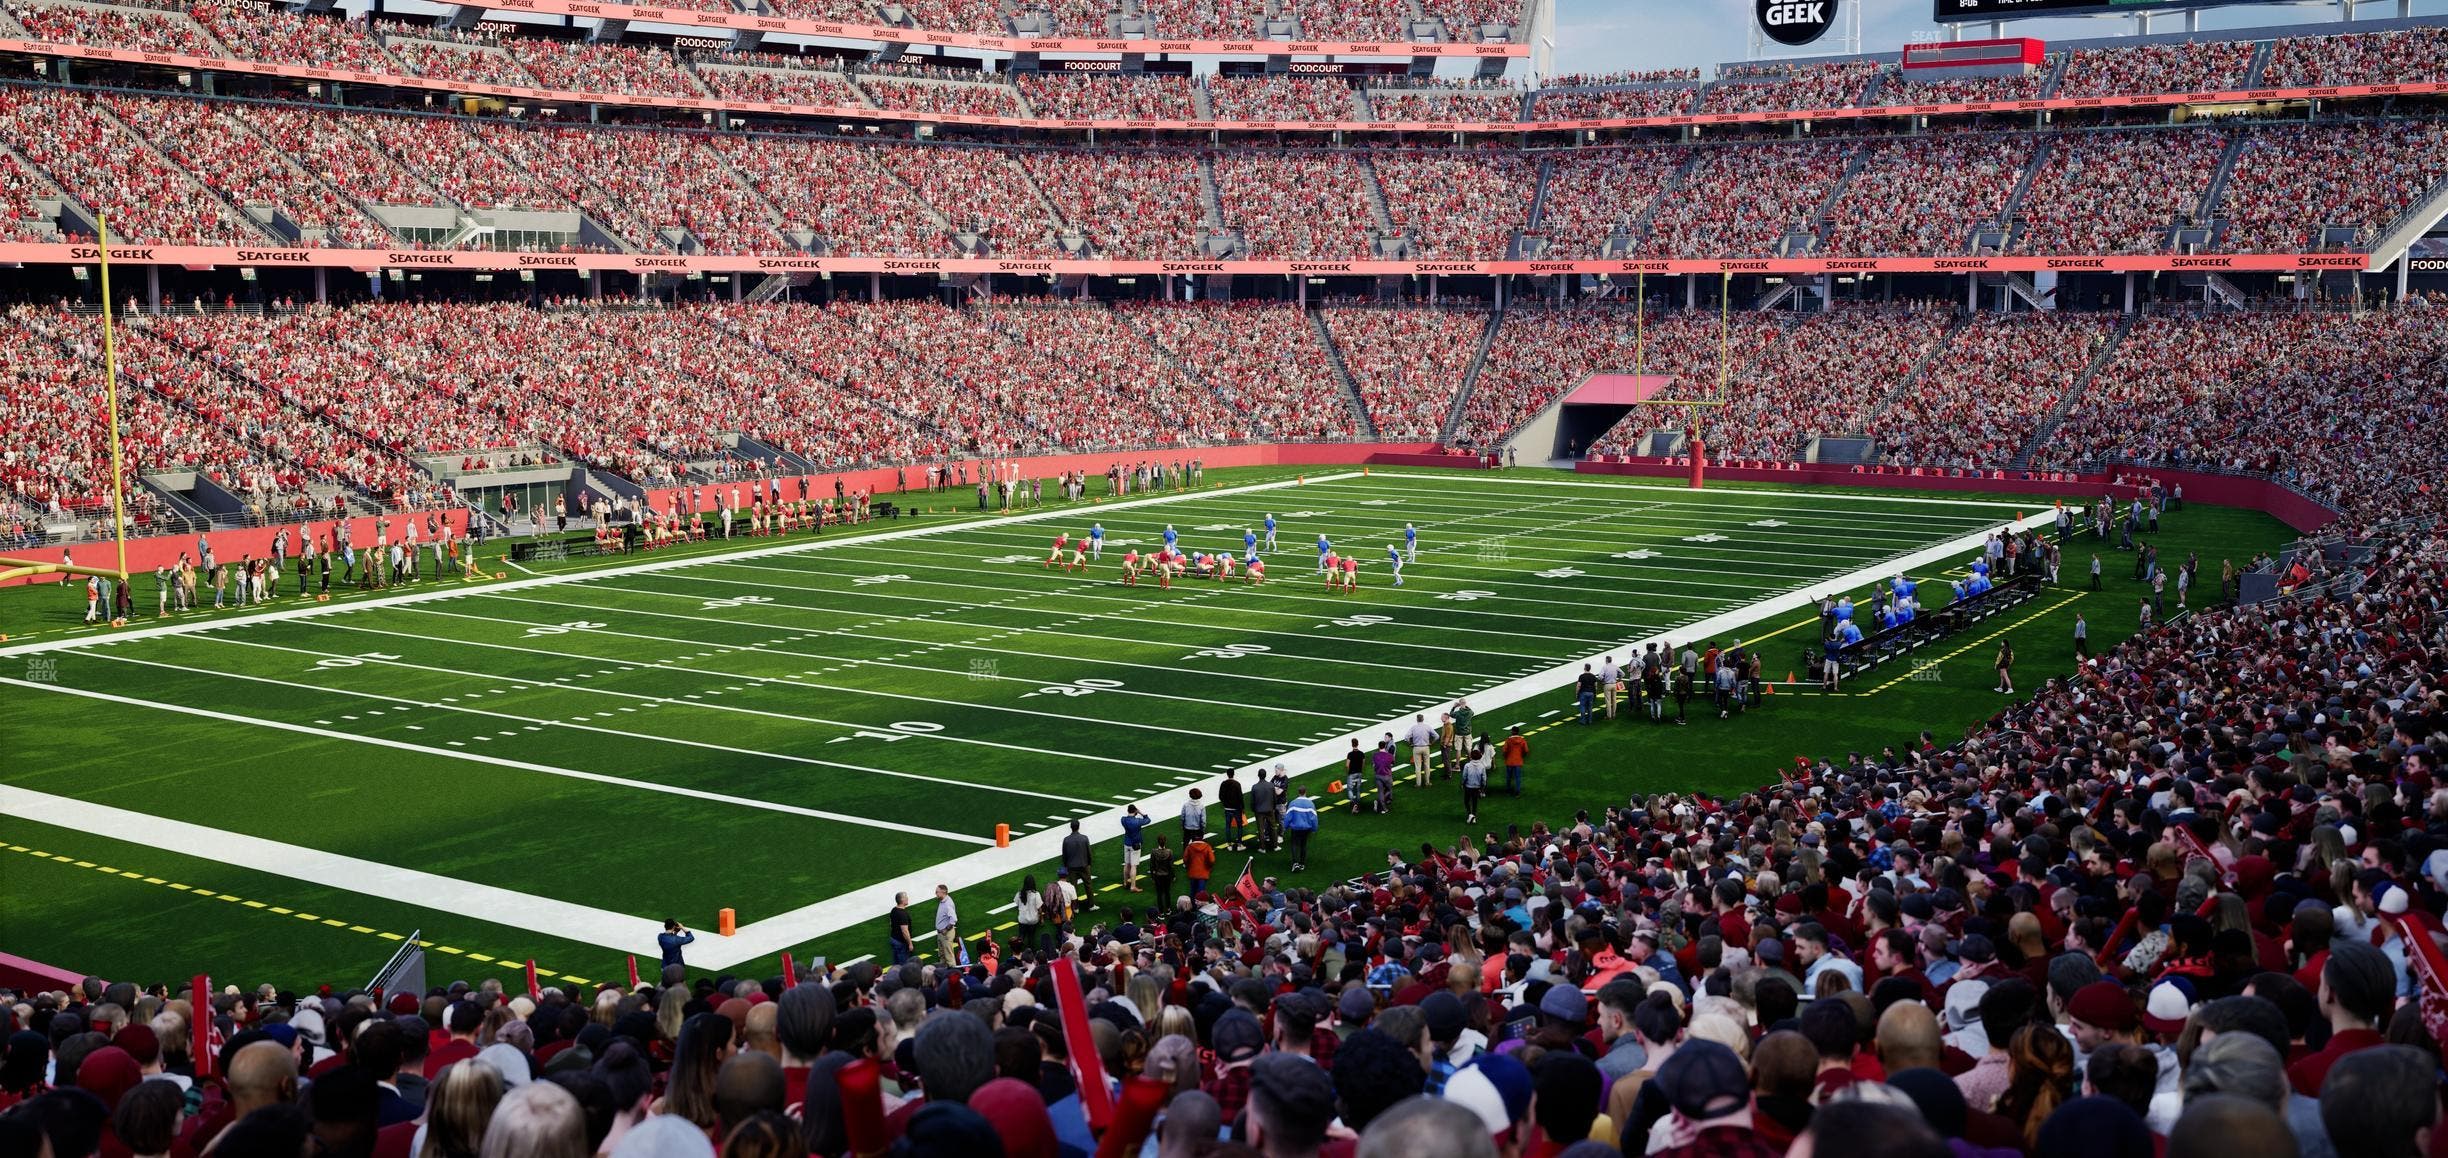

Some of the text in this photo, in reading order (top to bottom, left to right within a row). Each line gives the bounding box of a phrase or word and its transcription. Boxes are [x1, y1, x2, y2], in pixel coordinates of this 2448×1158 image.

[501, 0, 534, 8] SEATGEEK
[568, 4, 600, 13] SEATGEEK
[632, 9, 663, 18] SEATGEEK
[1766, 2, 1824, 26] GEEK
[697, 15, 727, 24] SEATGEEK
[757, 20, 786, 28] SEATGEEK
[815, 25, 842, 33] SEATGEEK
[873, 30, 899, 38] SEATGEEK
[927, 34, 952, 42] SEATGEEK
[675, 37, 732, 48] FOODCOURT
[24, 43, 54, 53] SEATGEEK
[84, 49, 112, 58] SEATGEEK
[144, 54, 172, 63] SEATGEEK
[199, 59, 226, 68] SEATGEEK
[1064, 62, 1121, 70] FOODCOURT
[253, 64, 278, 73] SEATGEEK
[305, 68, 330, 77] SEATGEEK
[2308, 88, 2338, 96] SEATGEEK
[2369, 85, 2400, 93] SEATGEEK
[1965, 103, 1991, 111] SEATGEEK
[71, 248, 154, 260] SEAGEEK
[237, 251, 310, 262] SEATGEEK
[388, 254, 453, 263] SEATGEEK
[519, 256, 576, 265] SEATGEEK
[634, 258, 687, 267] SEATGEEK
[759, 260, 820, 269] SEATGEEK
[883, 261, 940, 269] SEATGEEK
[1933, 260, 1988, 269] SEATGEEK
[2047, 259, 2105, 268] SEATGEEK
[2171, 258, 2232, 267] SEATGEEK
[2298, 257, 2362, 266] SEATGEEK
[999, 263, 1052, 271] SEATGEEK
[1162, 264, 1224, 272] SEATGEEK
[1289, 264, 1351, 272] SEATGEEK
[1415, 264, 1477, 272] SEATGEEK
[1529, 264, 1574, 272] SEATGEEK
[1622, 263, 1670, 271] SEATGEEK
[1719, 262, 1768, 270] SEATGEEK
[1825, 261, 1878, 270] SEATGEEK
[1331, 614, 1394, 627] 40
[1195, 644, 1271, 659] 30
[1038, 678, 1125, 698] 20
[853, 721, 944, 742] 10
